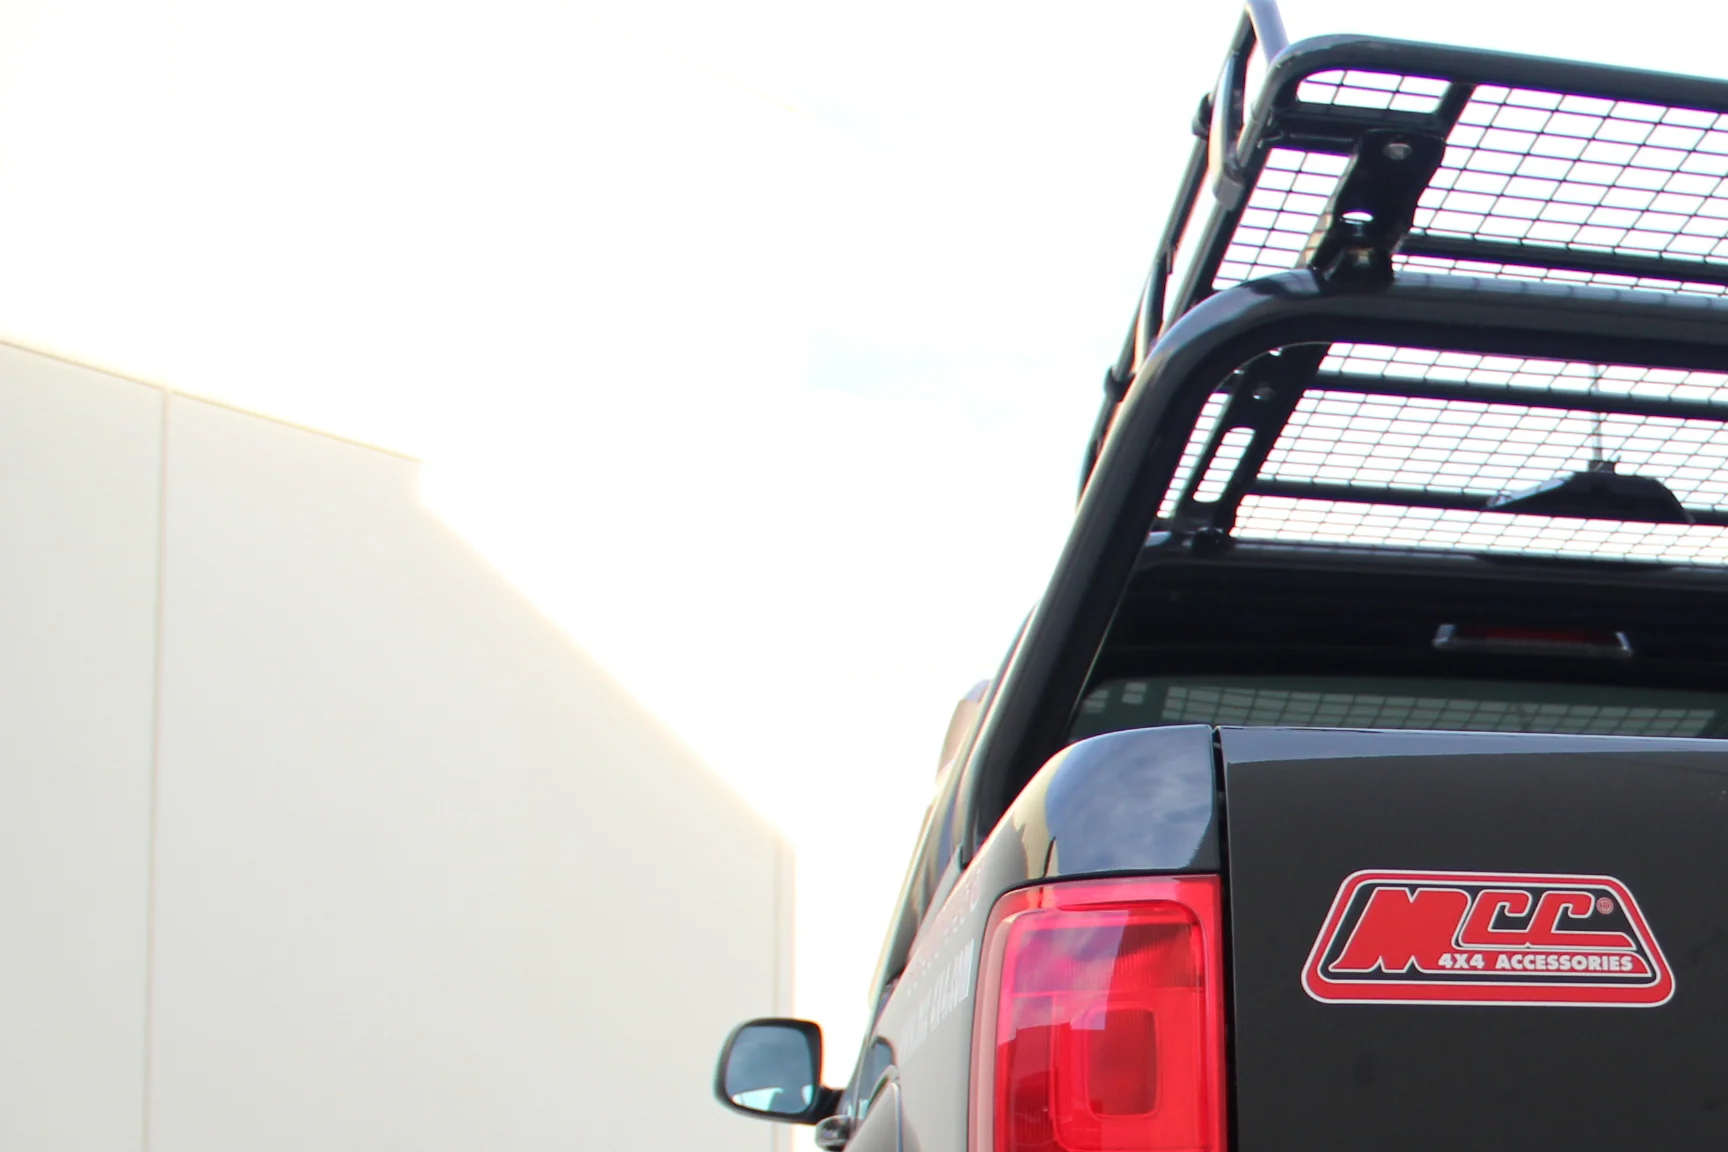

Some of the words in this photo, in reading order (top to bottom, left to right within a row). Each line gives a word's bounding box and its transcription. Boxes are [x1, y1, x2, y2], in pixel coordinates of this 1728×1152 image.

[1328, 886, 1638, 973] MCC
[1438, 952, 1485, 969] 4X4
[1495, 952, 1633, 971] ACCESSORIES
